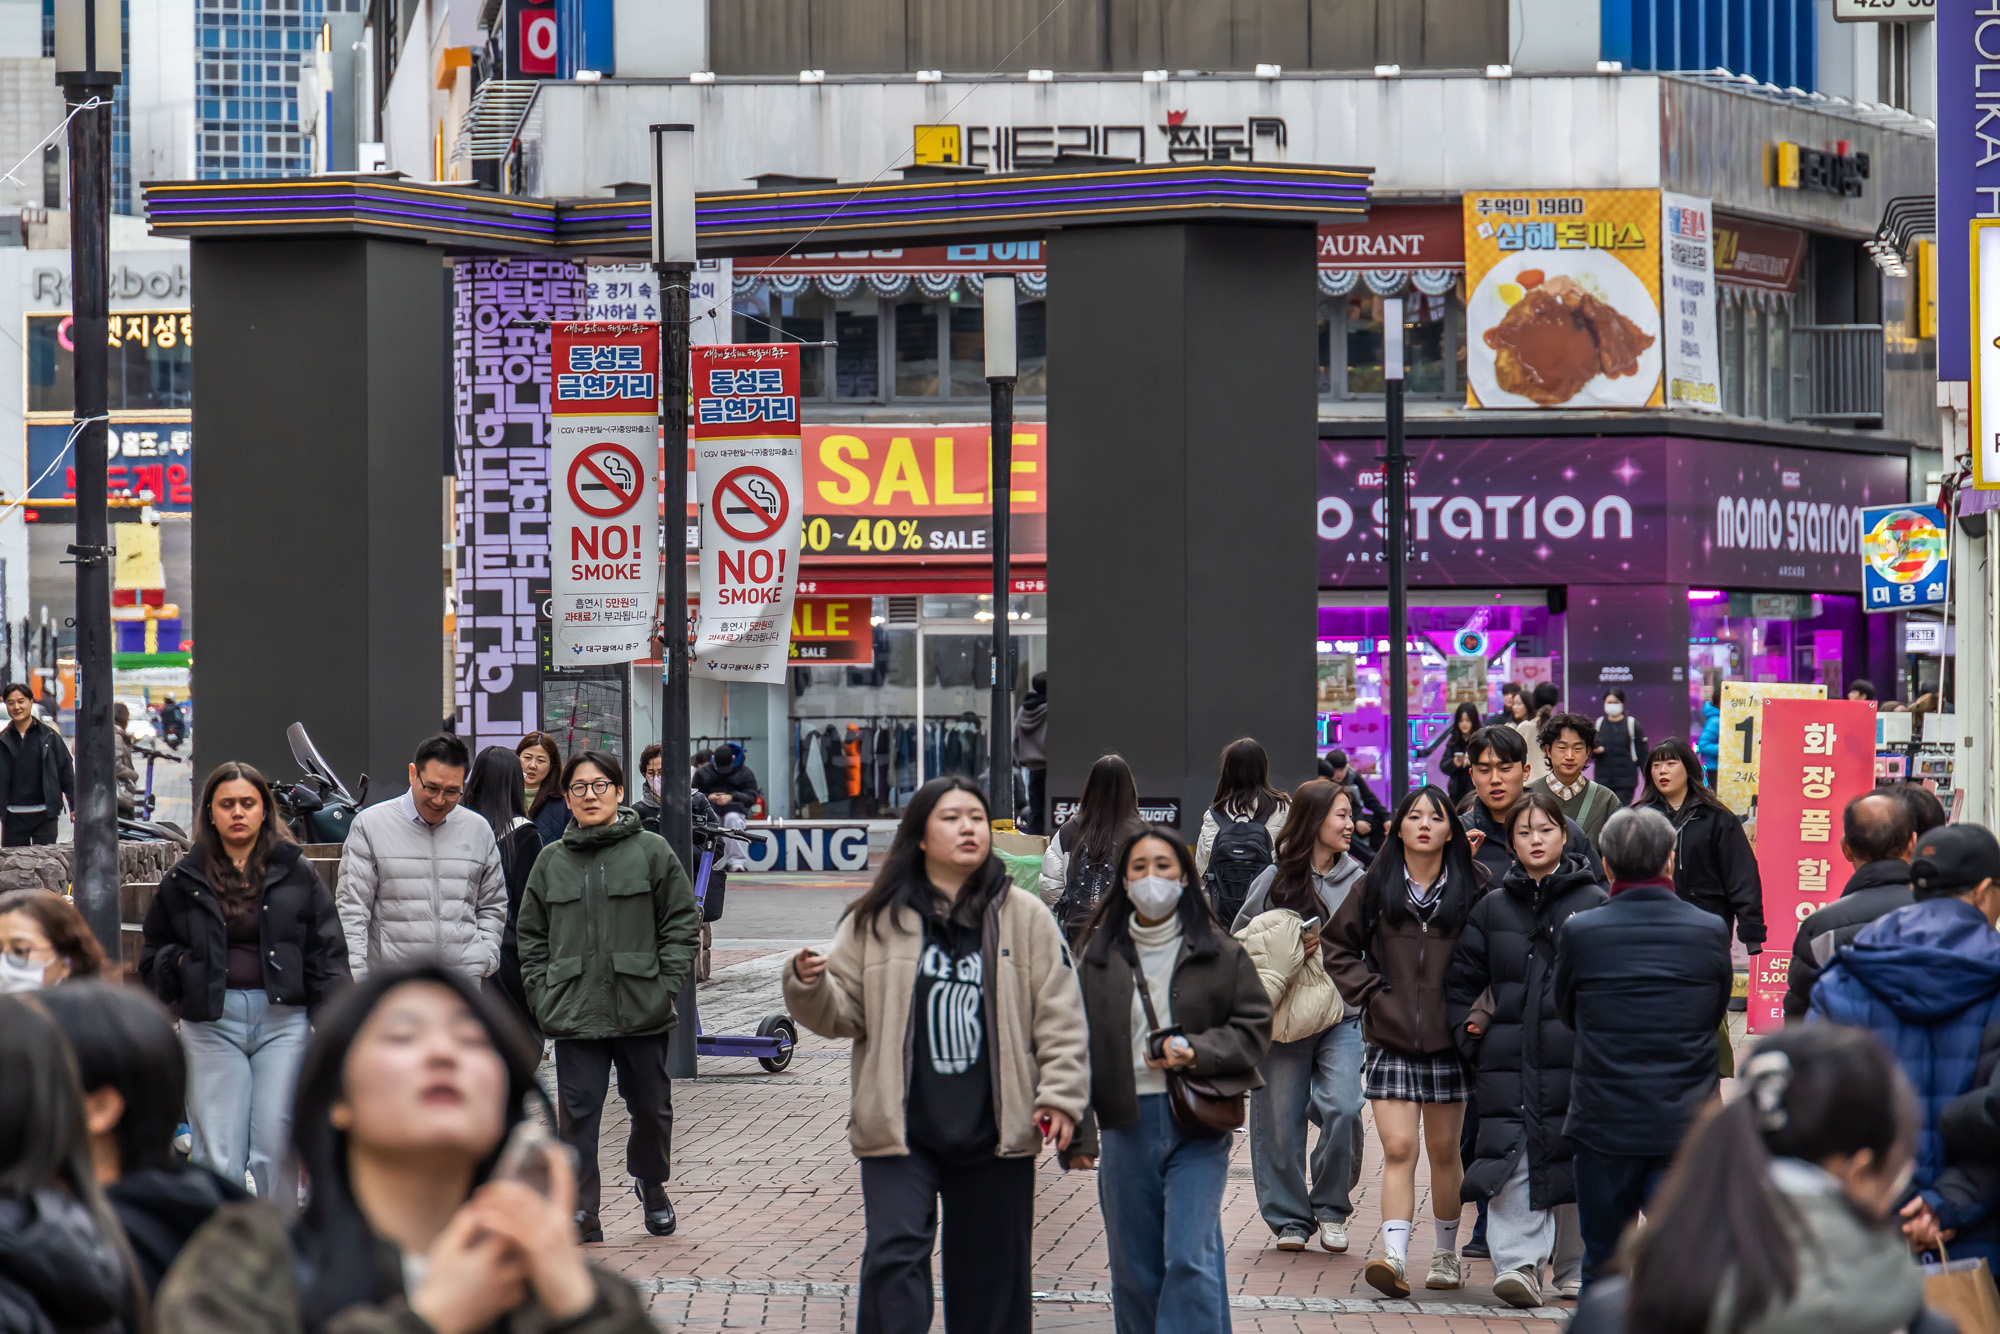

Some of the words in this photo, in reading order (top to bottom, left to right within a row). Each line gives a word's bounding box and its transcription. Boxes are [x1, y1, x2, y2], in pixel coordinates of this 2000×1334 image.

[1476, 197, 1531, 217] 추억의
[1535, 197, 1586, 217] 1980
[605, 283, 633, 300] 경기
[638, 283, 652, 300] 속
[643, 304, 657, 320] 수
[569, 345, 643, 372] 동성로
[558, 373, 655, 401] 금연거리
[709, 368, 784, 396] 동성로
[699, 396, 796, 425] 금연거리
[561, 426, 576, 434] CGV
[704, 450, 718, 458] CGV
[817, 433, 1038, 506] SALE
[571, 524, 641, 561] NO!
[801, 517, 923, 552] 0~40%
[929, 530, 986, 549] SALE
[571, 563, 642, 581] SMOKE
[718, 548, 787, 585] NO!
[718, 587, 782, 605] SMOKE
[1872, 582, 1945, 604] 미용실
[575, 598, 603, 609] 흡연시
[605, 597, 639, 608] 5만원의
[564, 610, 601, 622] 과태료가
[604, 609, 648, 622] 부과됩니다
[789, 604, 849, 636] ALE
[720, 621, 746, 632] 흡연시
[749, 620, 774, 631] 5만원의
[708, 632, 743, 643] 과태료가
[744, 631, 779, 643] 부과됩니다
[586, 644, 624, 653] 대구광역시
[625, 642, 640, 652] 중구
[720, 663, 755, 671] 대구광역시
[755, 663, 770, 671] 중구
[1799, 722, 1837, 842] 화장품
